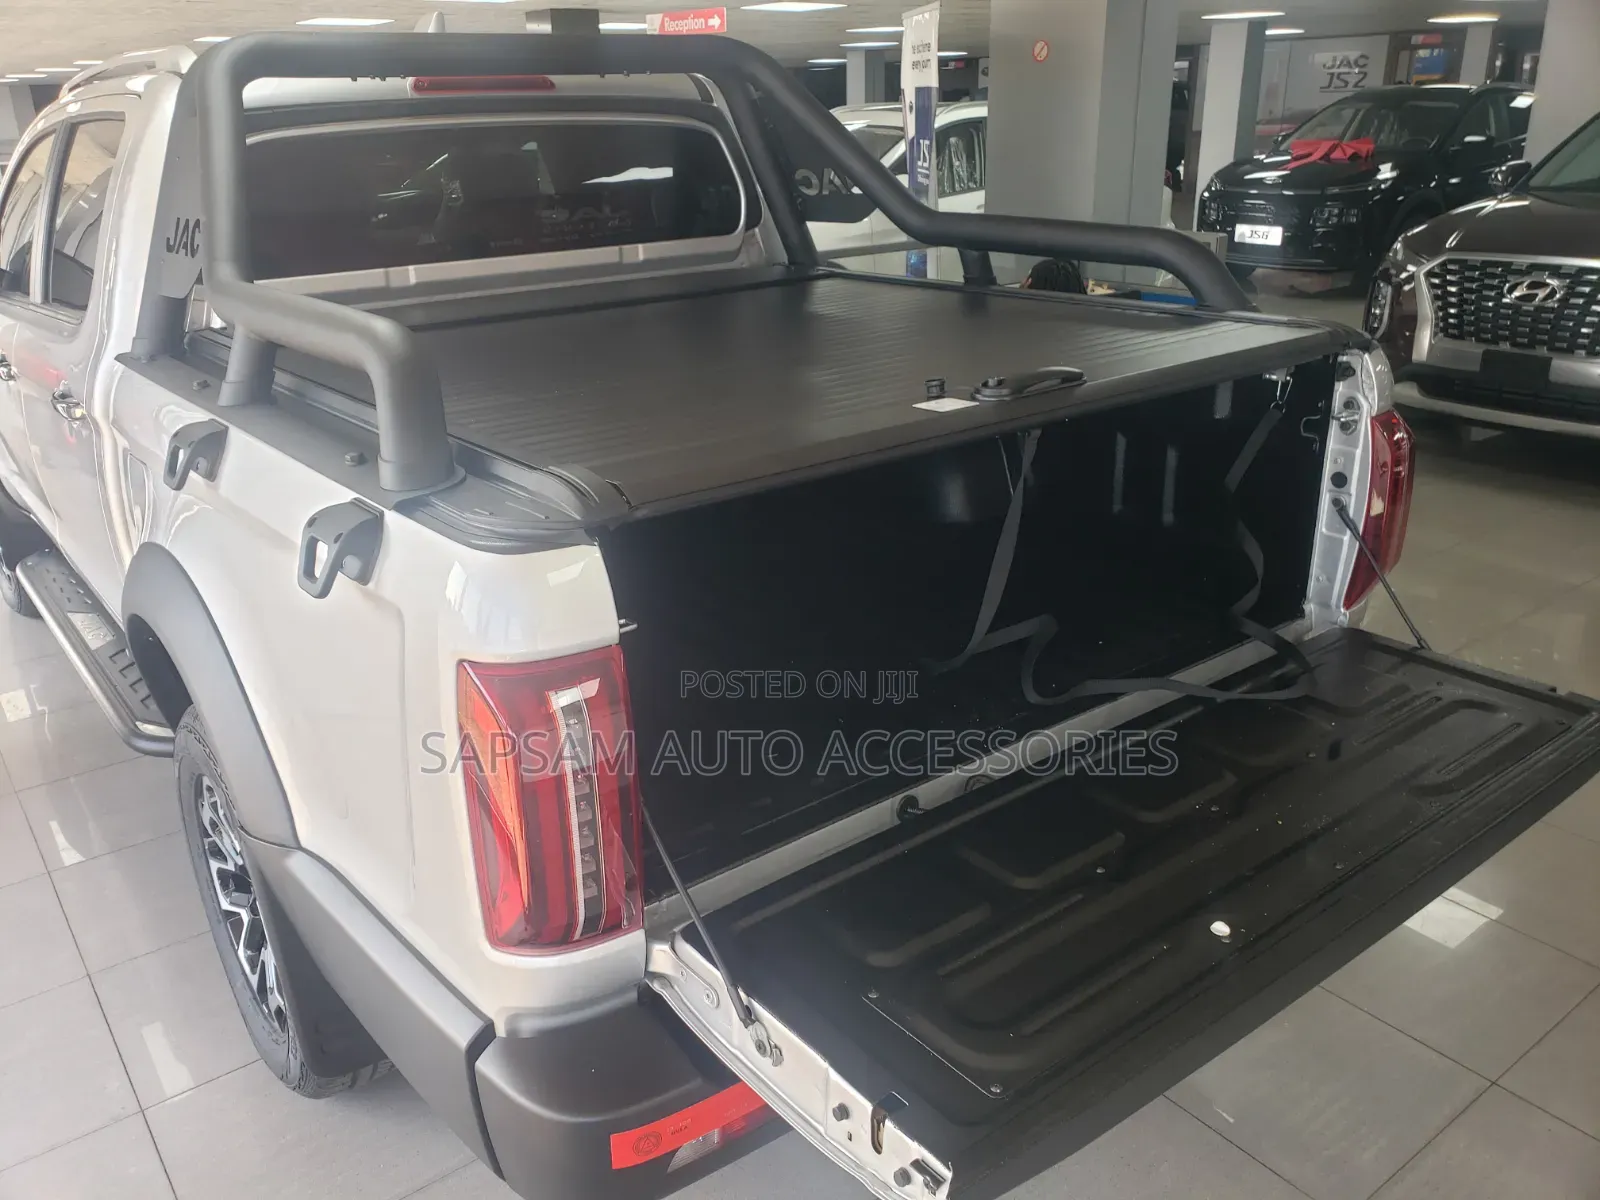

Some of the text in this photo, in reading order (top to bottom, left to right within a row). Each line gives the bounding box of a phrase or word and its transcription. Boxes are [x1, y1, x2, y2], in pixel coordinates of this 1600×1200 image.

[664, 14, 705, 34] Reception
[1322, 54, 1370, 70] JAC
[166, 216, 201, 259] JAC
